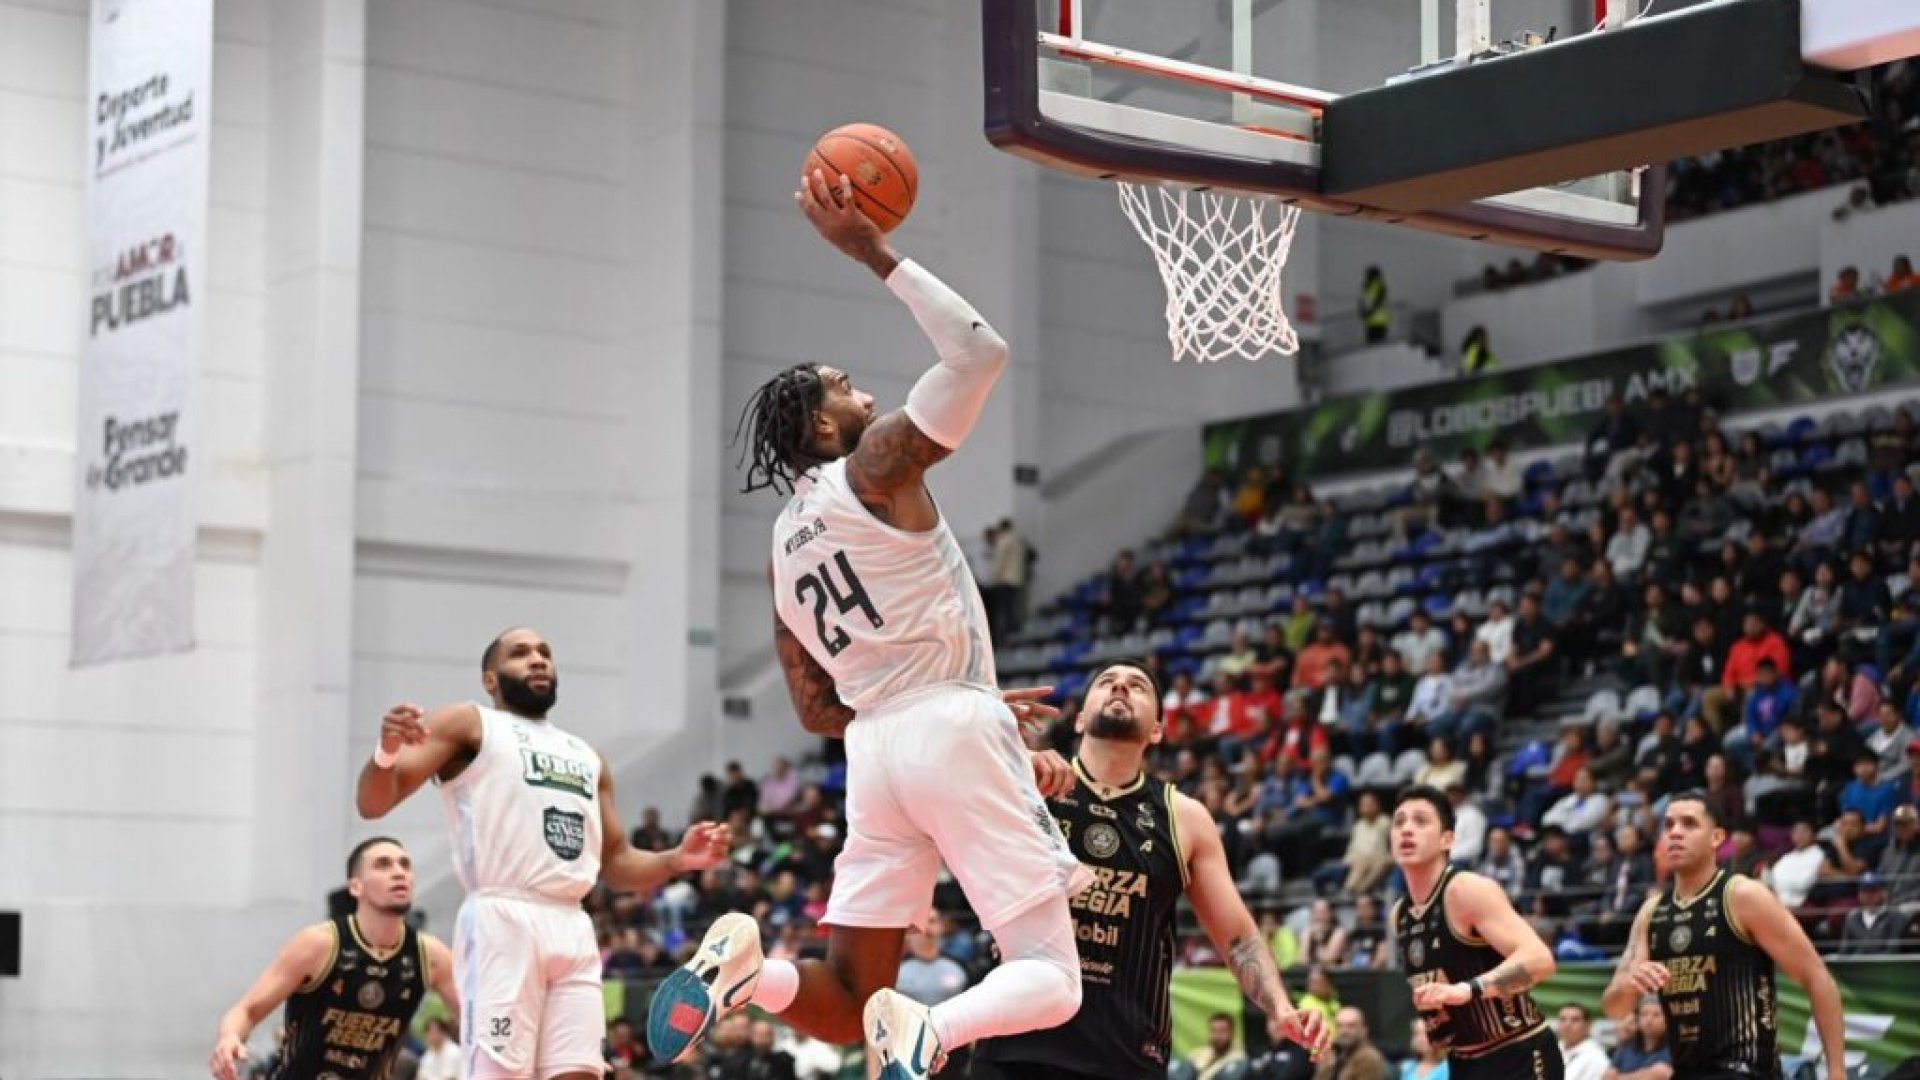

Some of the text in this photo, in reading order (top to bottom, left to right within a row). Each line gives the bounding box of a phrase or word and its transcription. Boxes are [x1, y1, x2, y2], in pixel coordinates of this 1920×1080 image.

[91, 265, 190, 338] PUEBLA
[794, 549, 884, 659] 24
[1094, 866, 1148, 899] RZA
[1070, 888, 1131, 918] EGIA
[490, 1017, 512, 1036] 32
